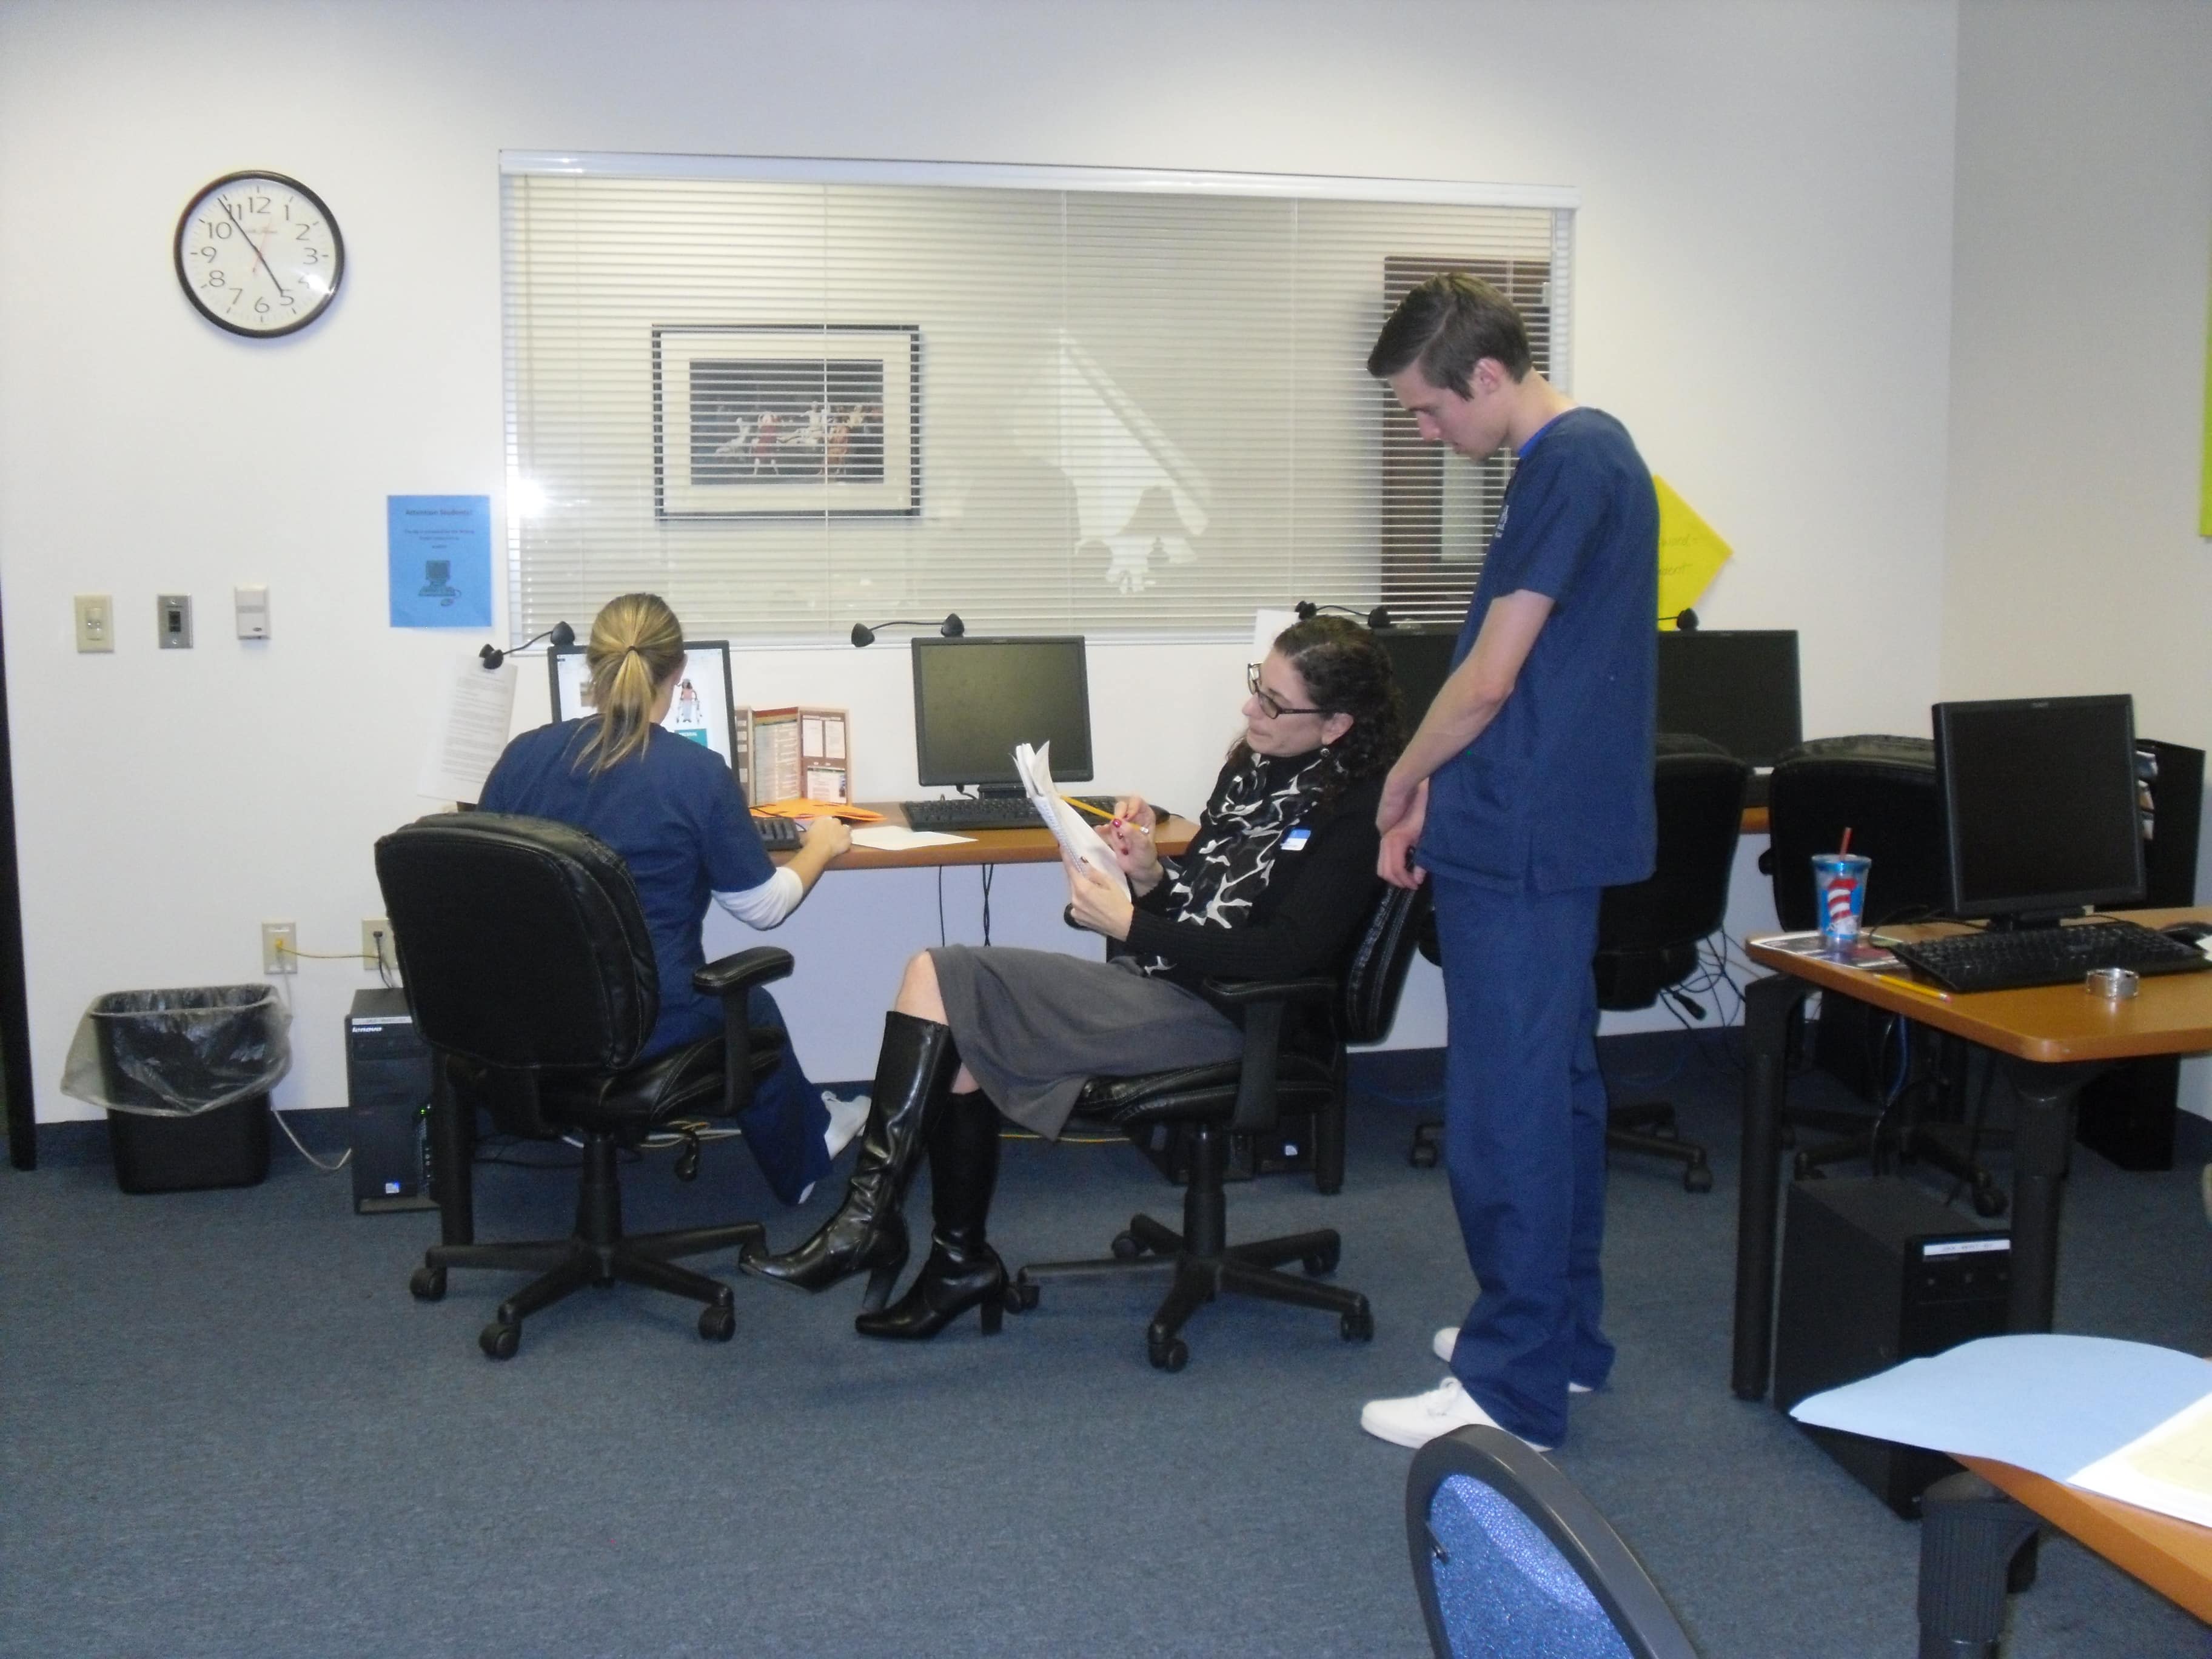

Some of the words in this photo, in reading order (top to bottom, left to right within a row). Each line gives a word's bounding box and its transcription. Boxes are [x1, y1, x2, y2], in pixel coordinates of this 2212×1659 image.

[228, 203, 243, 220] 11
[247, 196, 270, 213] 12
[284, 204, 290, 221] 1
[207, 221, 232, 239] 10
[295, 223, 310, 241] 2
[201, 246, 217, 263] 9
[303, 247, 318, 264] 3
[209, 270, 225, 287] 8
[229, 287, 243, 304] 7
[280, 289, 295, 306] 5
[254, 297, 270, 313] 6
